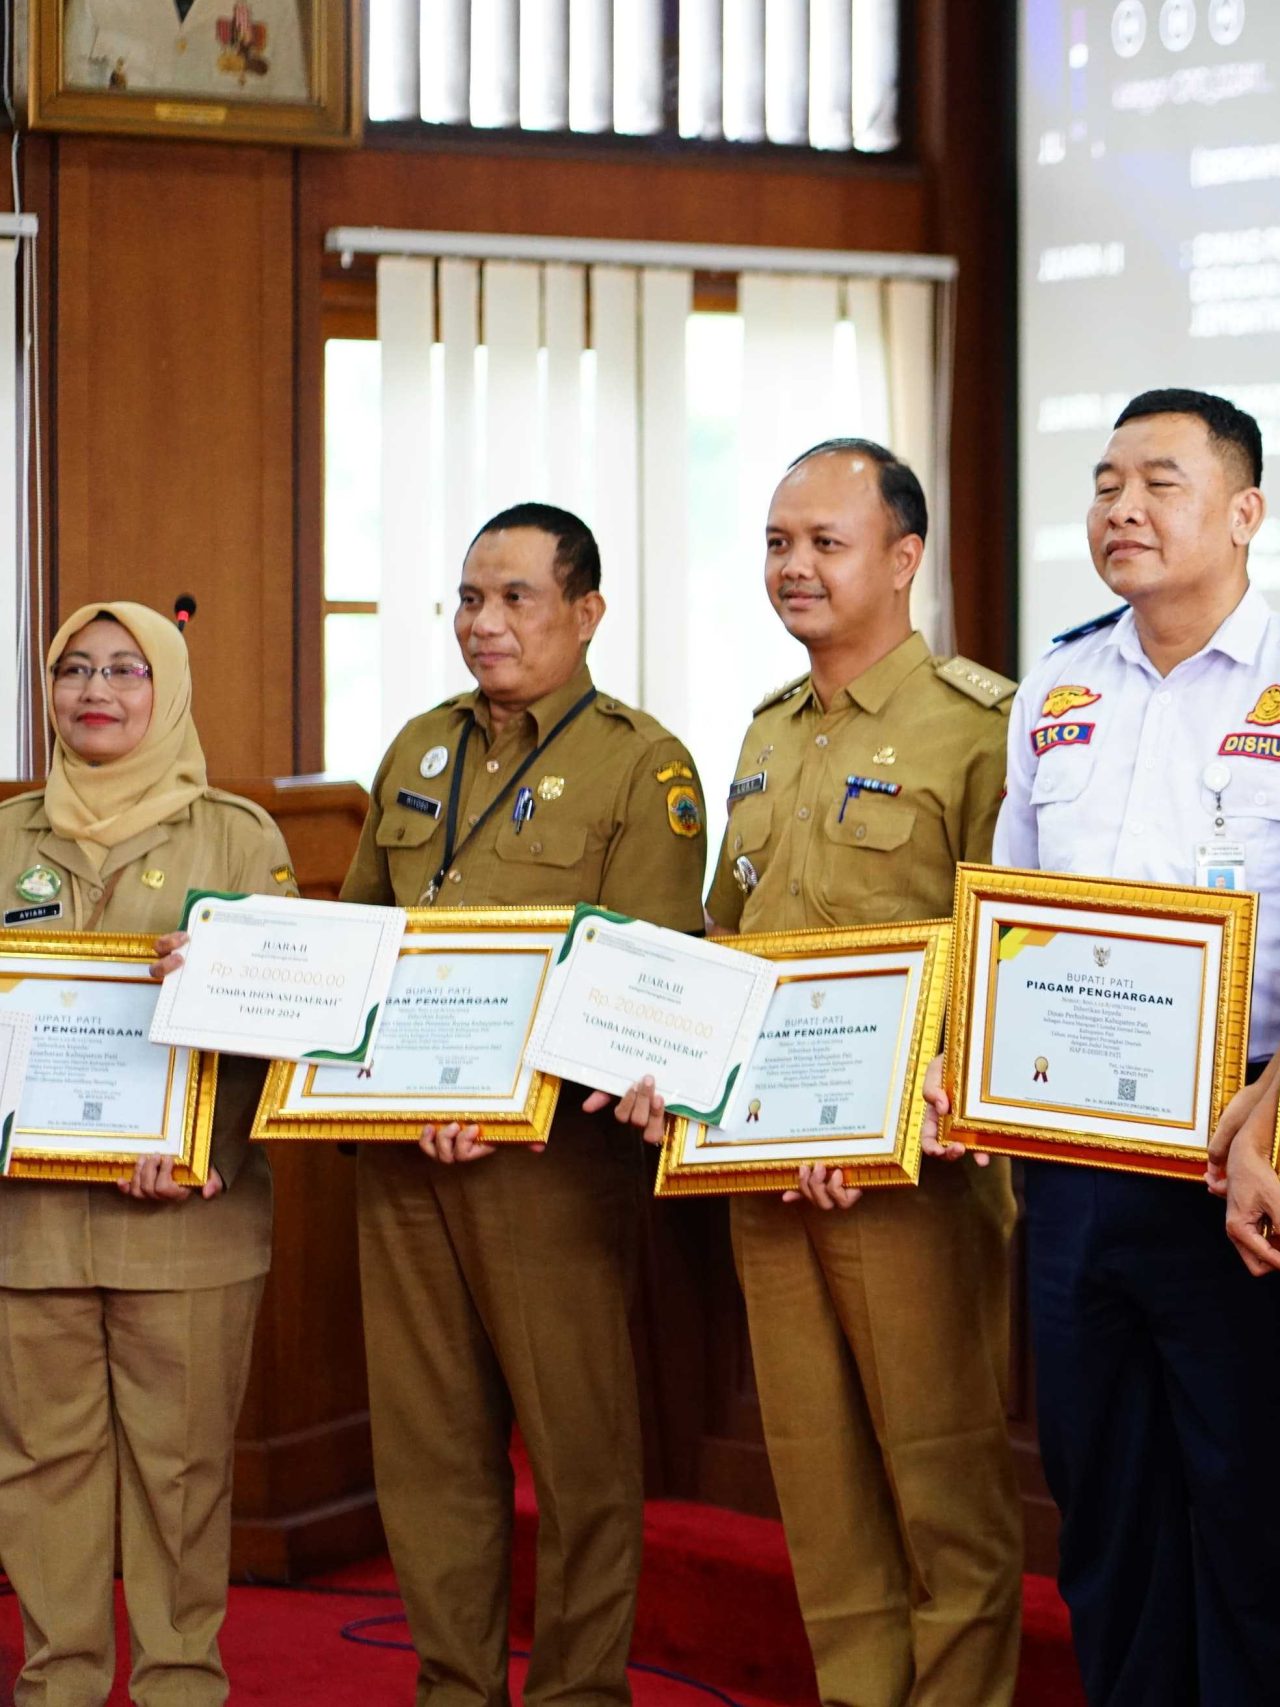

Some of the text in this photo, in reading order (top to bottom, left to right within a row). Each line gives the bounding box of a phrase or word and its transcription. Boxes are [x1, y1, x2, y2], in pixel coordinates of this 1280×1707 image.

[1036, 725, 1080, 749] EKO
[262, 940, 296, 952] JUARA
[637, 972, 670, 991] JUARA
[1066, 972, 1134, 989] BUPATI PATI
[448, 987, 472, 995] PATI
[1026, 980, 1074, 994] PIAGAM
[1079, 986, 1174, 1006] PENGHARGAAN
[415, 996, 509, 1005] PENGHARGAAN
[36, 1015, 103, 1025] UPATI PATI
[784, 1015, 844, 1027] BUPATI PATI
[43, 1025, 143, 1037] PENGHARGAAN
[758, 1024, 878, 1040] AGAM PENGHARGAAN
[610, 1040, 667, 1067] TAHUN 2024
